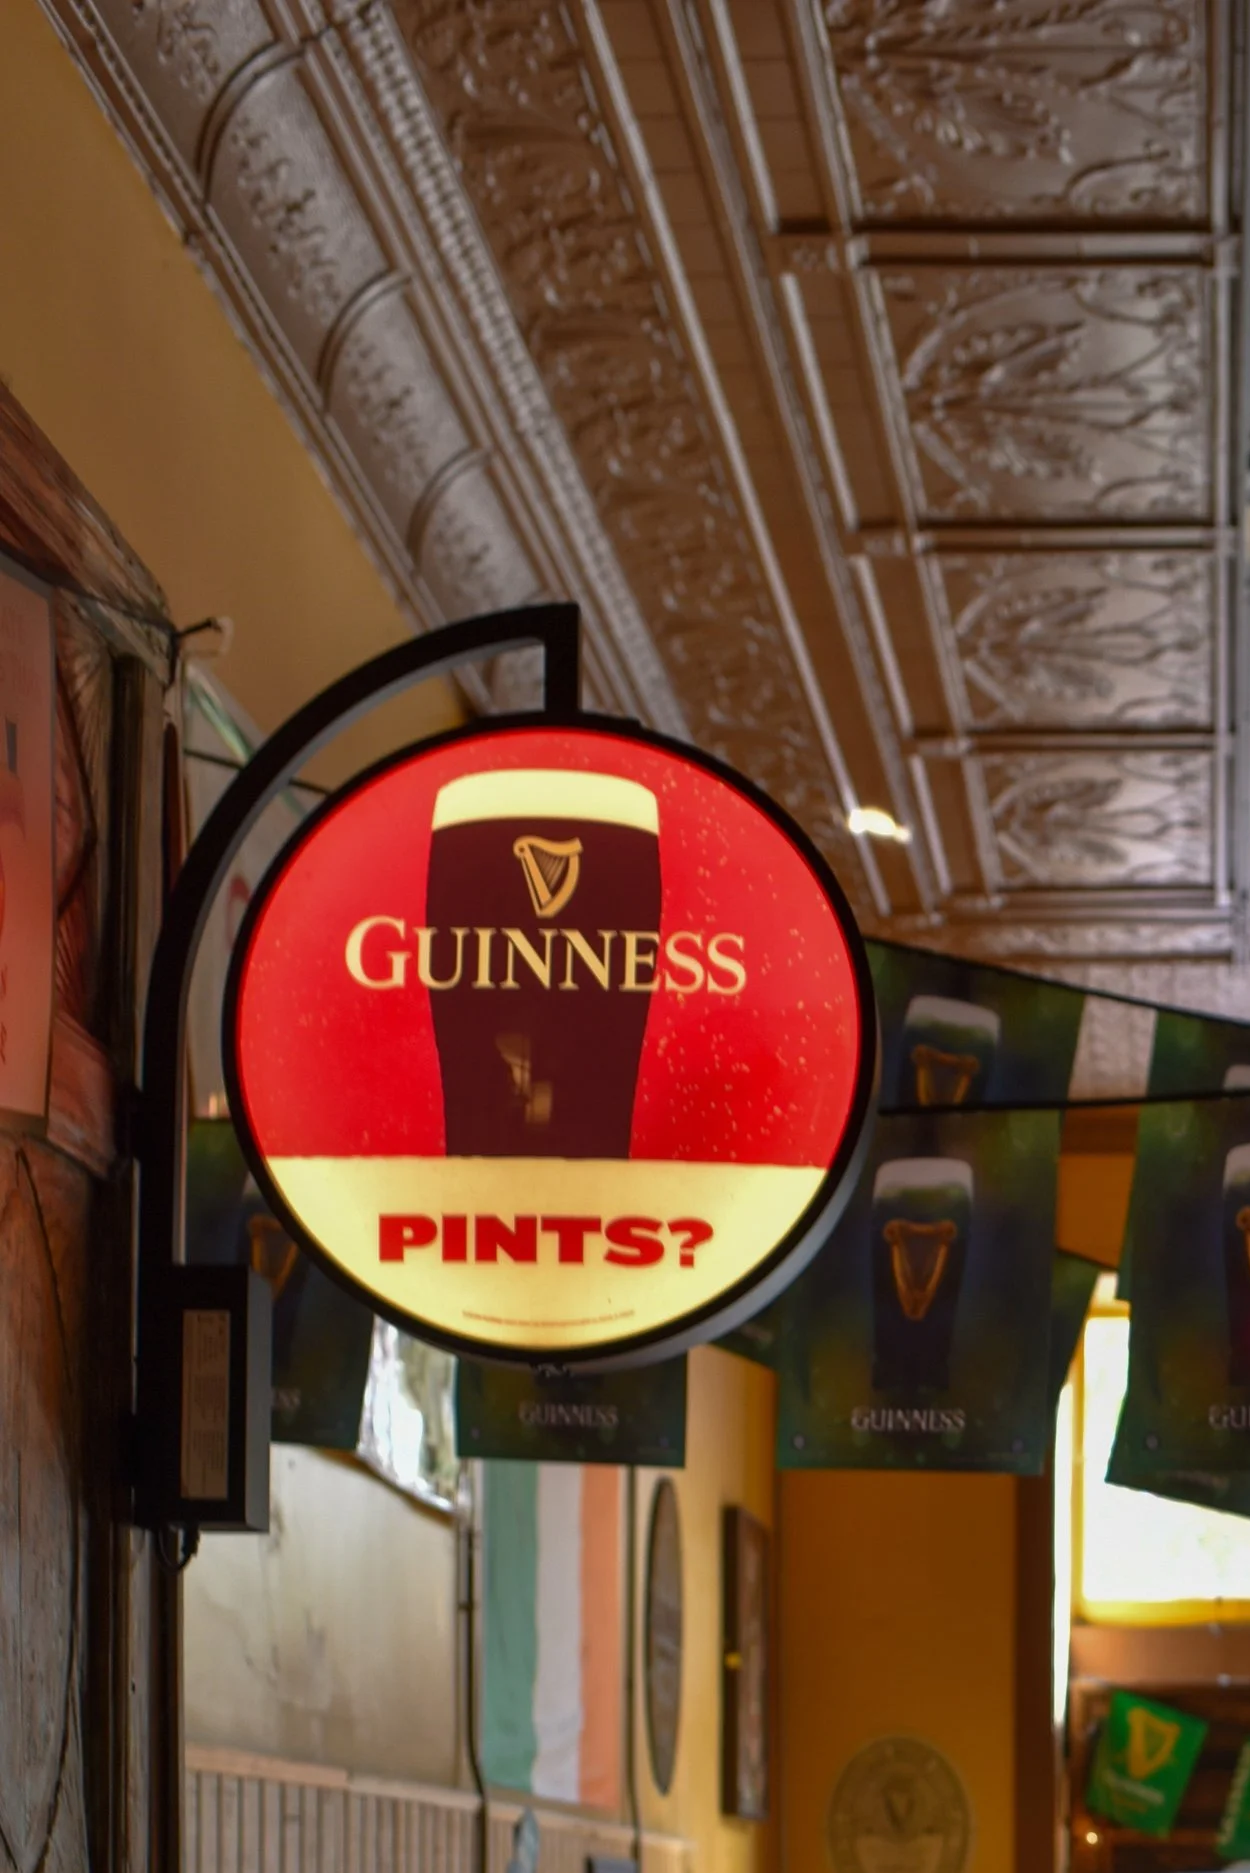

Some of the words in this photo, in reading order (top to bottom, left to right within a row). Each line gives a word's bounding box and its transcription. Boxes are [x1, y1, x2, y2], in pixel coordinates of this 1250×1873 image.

[344, 915, 747, 996] GUINNESS
[378, 1213, 715, 1269] PINTS?
[518, 1403, 620, 1429] GUINNESS
[850, 1406, 966, 1433] GUINNESS
